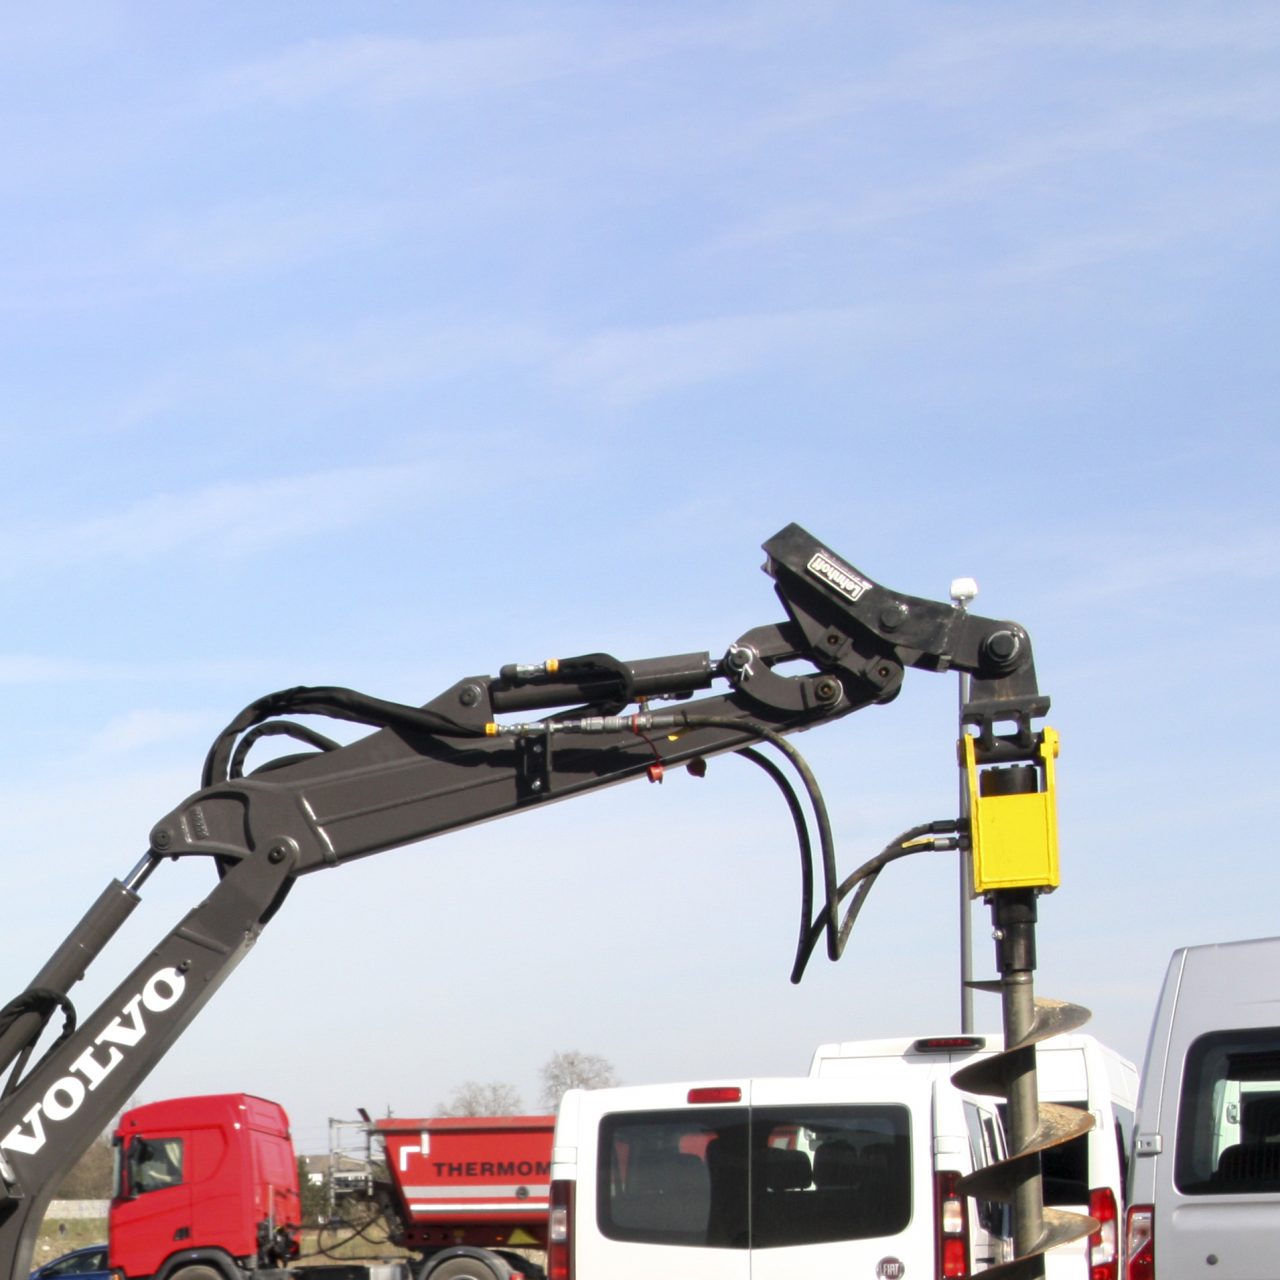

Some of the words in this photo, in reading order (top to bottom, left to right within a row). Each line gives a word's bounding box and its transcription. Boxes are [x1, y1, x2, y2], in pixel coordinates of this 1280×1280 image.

[810, 557, 862, 598] Lehnhoff
[0, 967, 186, 1155] VOLVO
[883, 1263, 899, 1276] FIAT
